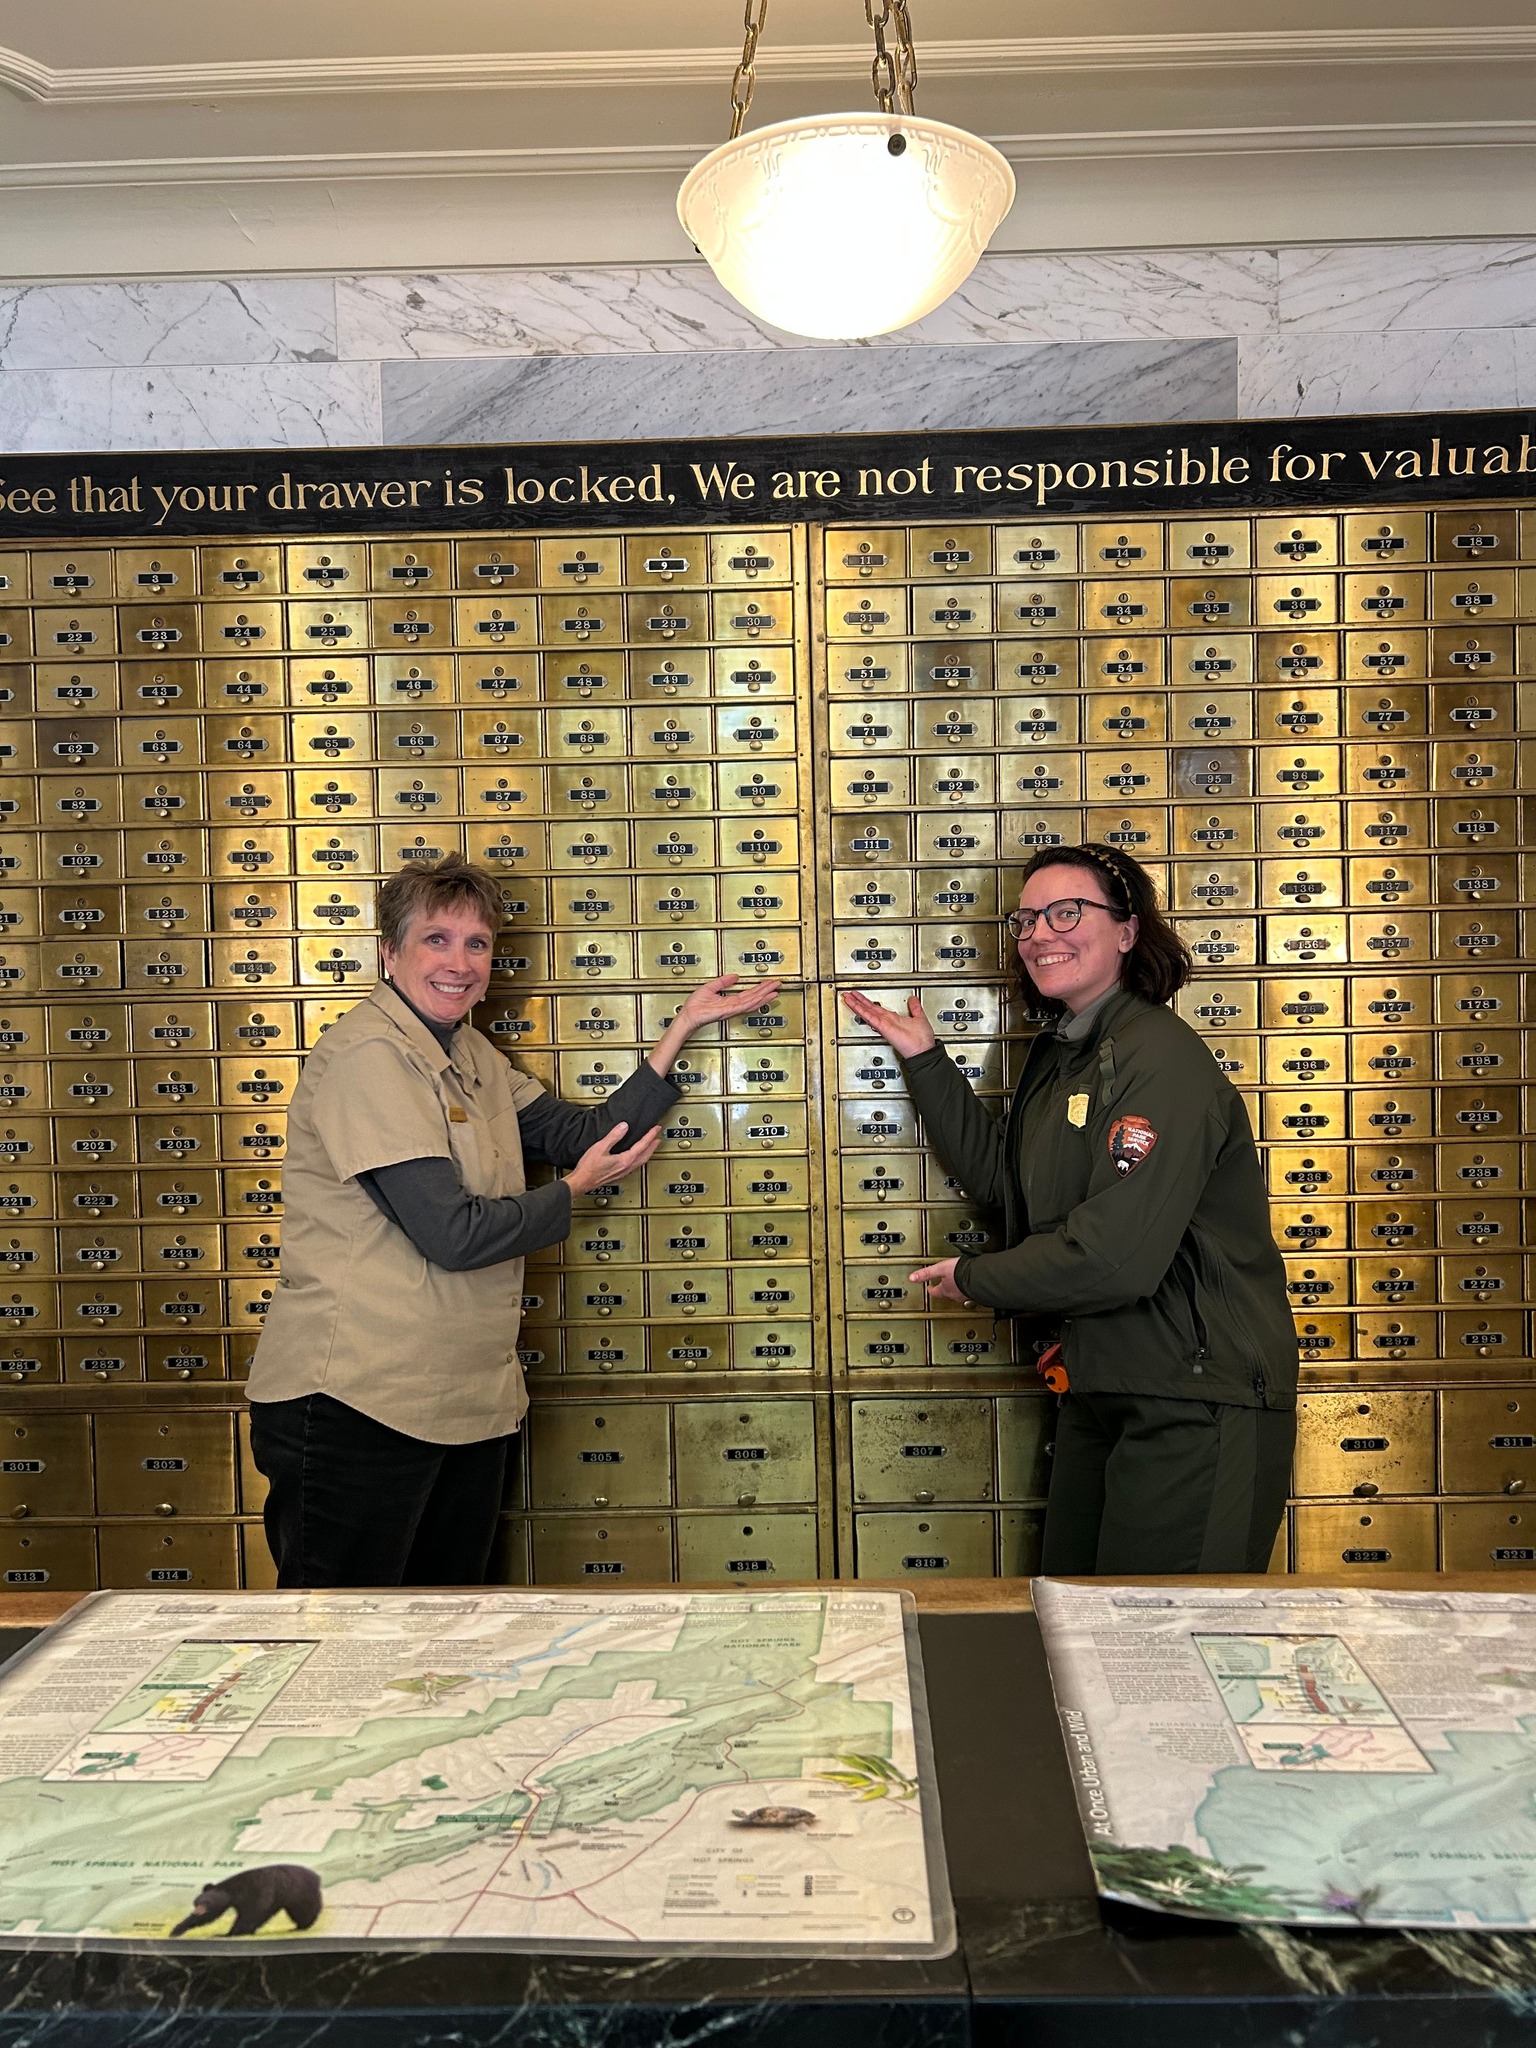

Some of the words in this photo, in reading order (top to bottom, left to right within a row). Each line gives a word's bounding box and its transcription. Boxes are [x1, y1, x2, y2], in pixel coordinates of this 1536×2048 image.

[67, 476, 145, 514] that
[152, 486, 258, 526] your
[269, 472, 431, 510] drawer
[445, 469, 484, 506] is
[505, 463, 676, 505] locked,
[689, 461, 755, 502] We
[771, 470, 841, 500] are
[857, 457, 935, 498] not
[953, 446, 1250, 506] responsible
[1267, 444, 1347, 483] for
[1379, 539, 1393, 549] 17
[1028, 551, 1043, 561] 13
[1116, 548, 1129, 558] 14
[1203, 546, 1218, 556] 15
[946, 552, 960, 562] 12
[492, 566, 500, 575] 7
[660, 561, 668, 571] 9
[66, 576, 75, 586] 2
[151, 574, 160, 584] 3
[1377, 599, 1394, 609] 37
[1464, 595, 1481, 606] 38
[1030, 607, 1045, 617] 33
[1116, 605, 1132, 616] 34
[403, 623, 419, 633] 26
[489, 622, 505, 632] 27
[574, 620, 591, 630] 28
[67, 632, 83, 642] 22
[151, 631, 168, 641] 23
[1464, 653, 1481, 663] 58
[1117, 663, 1133, 673] 54
[1204, 660, 1220, 670] 55
[860, 669, 874, 679] 51
[944, 668, 960, 678] 52
[406, 680, 422, 690] 46
[491, 679, 507, 689] 47
[662, 675, 679, 685] 49
[66, 688, 83, 697] 42
[1378, 712, 1393, 721] 77
[1465, 710, 1481, 719] 78
[1031, 722, 1046, 731] 73
[1205, 718, 1220, 727] 75
[863, 727, 876, 736] 71
[946, 724, 961, 734] 72
[494, 735, 509, 744] 67
[663, 732, 678, 742] 69
[67, 744, 83, 754] 62
[1379, 769, 1396, 778] 97
[948, 781, 963, 791] 92
[1034, 779, 1049, 788] 93
[1119, 776, 1134, 786] 94
[751, 786, 766, 796] 90
[862, 783, 877, 793] 91
[495, 791, 511, 801] 87
[580, 790, 596, 800] 88
[71, 800, 86, 810] 82
[1466, 823, 1486, 833] 118
[1032, 834, 1053, 844] 113
[1117, 832, 1138, 842] 114
[750, 842, 770, 852] 110
[946, 838, 968, 847] 112
[579, 846, 602, 855] 108
[665, 844, 686, 854] 109
[70, 856, 92, 865] 102
[155, 853, 176, 863] 103
[1467, 879, 1489, 889] 138
[1205, 886, 1228, 896] 135
[749, 897, 772, 907] 130
[946, 893, 967, 903] 132
[666, 900, 688, 910] 129
[71, 911, 94, 921] 122
[155, 909, 177, 919] 123
[1380, 938, 1402, 948] 157
[1467, 936, 1489, 945] 158
[750, 953, 772, 963] 150
[864, 950, 884, 960] 151
[949, 948, 970, 958] 152
[666, 955, 688, 965] 149
[70, 966, 92, 976] 142
[155, 965, 177, 975] 143
[1381, 1002, 1404, 1012] 177
[1466, 1000, 1491, 1009] 178
[1207, 1006, 1231, 1016] 175
[951, 1012, 972, 1021] 172
[79, 1030, 100, 1040] 162
[162, 1028, 183, 1037] 163
[1295, 1060, 1318, 1070] 196
[1382, 1058, 1404, 1068] 197
[754, 1071, 777, 1081] 190
[867, 1069, 888, 1079] 191
[165, 1083, 187, 1094] 183
[1382, 1115, 1403, 1124] 217
[1468, 1112, 1491, 1122] 218
[673, 1128, 695, 1138] 209
[869, 1124, 890, 1134] 211
[82, 1141, 105, 1151] 202
[1297, 1172, 1322, 1182] 236
[1468, 1168, 1492, 1178] 238
[674, 1184, 697, 1194] 229
[758, 1182, 781, 1192] 230
[2, 1197, 24, 1207] 221
[1384, 1226, 1404, 1236] 257
[1468, 1224, 1491, 1234] 258
[676, 1238, 698, 1248] 249
[871, 1234, 894, 1243] 251
[5, 1252, 26, 1261] 241
[87, 1250, 111, 1260] 242
[169, 1249, 193, 1258] 243
[677, 1293, 699, 1303] 269
[761, 1291, 783, 1301] 270
[873, 1289, 895, 1299] 271
[4, 1307, 26, 1317] 261
[87, 1305, 110, 1315] 262
[678, 1349, 702, 1359] 289
[761, 1346, 785, 1356] 290
[875, 1344, 897, 1354] 291
[593, 1350, 616, 1360] 288
[91, 1360, 115, 1370] 282
[175, 1357, 197, 1367] 283
[1503, 1437, 1524, 1447] 311
[734, 1449, 758, 1460] 306
[9, 1462, 31, 1472] 301
[152, 1460, 176, 1470] 302
[592, 1563, 614, 1573] 317
[737, 1561, 759, 1571] 318
[914, 1558, 937, 1568] 319
[157, 1570, 179, 1580] 314
[1065, 1710, 1087, 1733] Wild
[1070, 1733, 1092, 1752] and
[1078, 1754, 1100, 1788] Urban
[1089, 1789, 1109, 1820] Once
[1094, 1820, 1113, 1838] At
